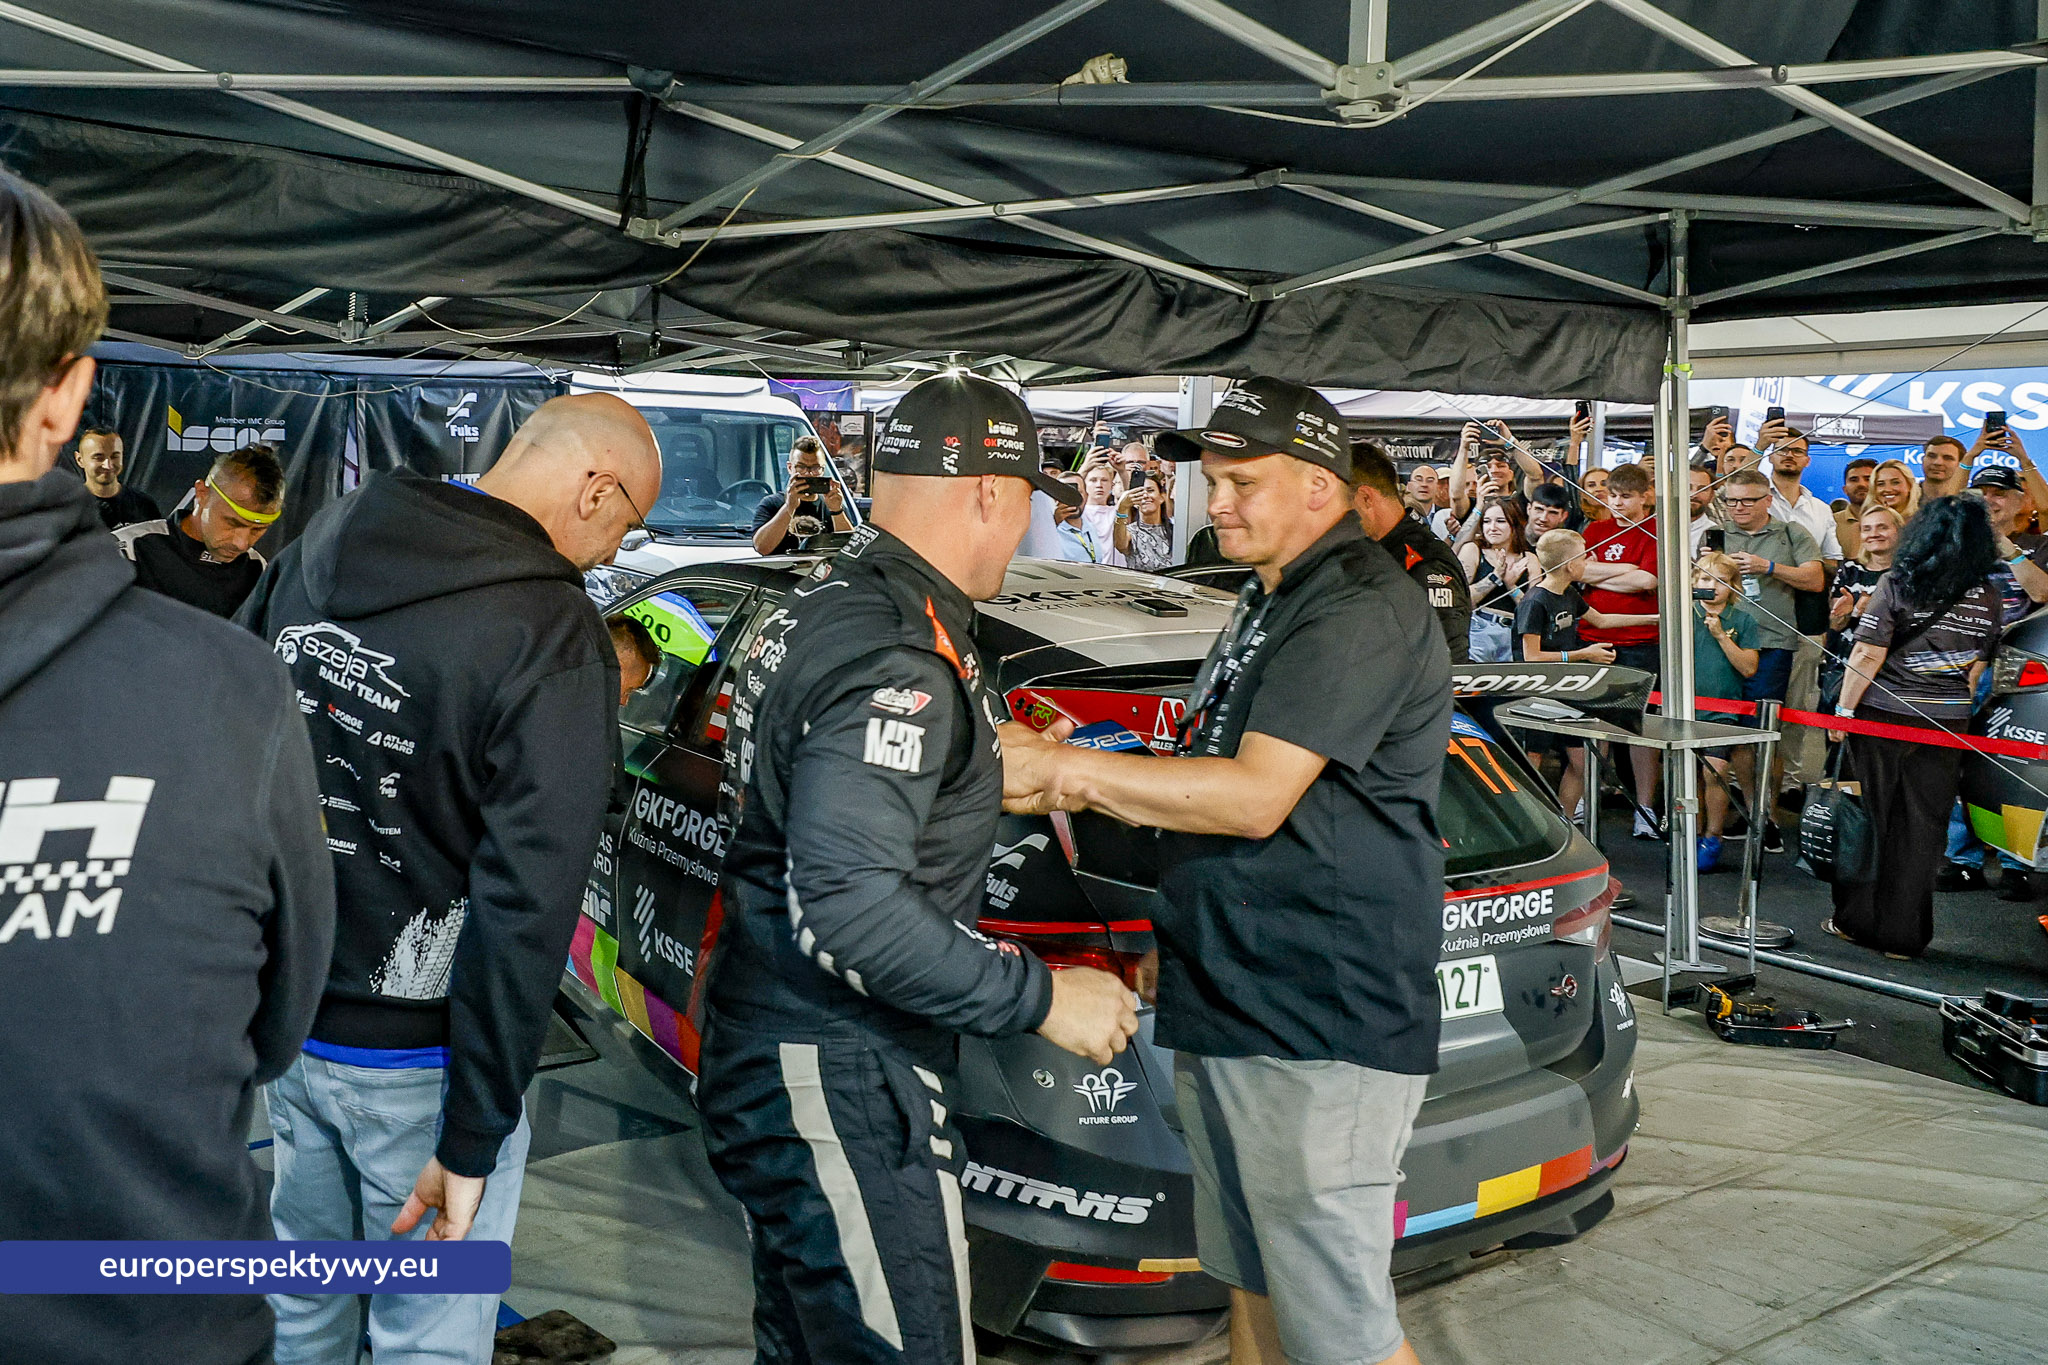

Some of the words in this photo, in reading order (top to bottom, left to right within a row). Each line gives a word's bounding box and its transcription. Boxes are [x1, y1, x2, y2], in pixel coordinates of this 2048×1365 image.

[214, 416, 245, 424] Member
[264, 418, 285, 426] Group
[450, 424, 479, 437] Fuks
[319, 665, 357, 692] RALLY
[357, 682, 401, 714] TEAM
[384, 734, 416, 748] ATLAS
[2003, 724, 2047, 745] KSSE
[383, 741, 413, 755] WARD
[634, 788, 726, 858] GKFORGE
[627, 825, 656, 854] Kuźnia
[658, 840, 719, 886] Przemysłowa
[1442, 888, 1554, 932] GKFORGE
[1481, 923, 1551, 947] Przemysłowa
[654, 927, 694, 977] KSSE
[1436, 963, 1482, 1011] 127
[1079, 1116, 1109, 1125] FUTURE
[1111, 1115, 1138, 1125] GROUP
